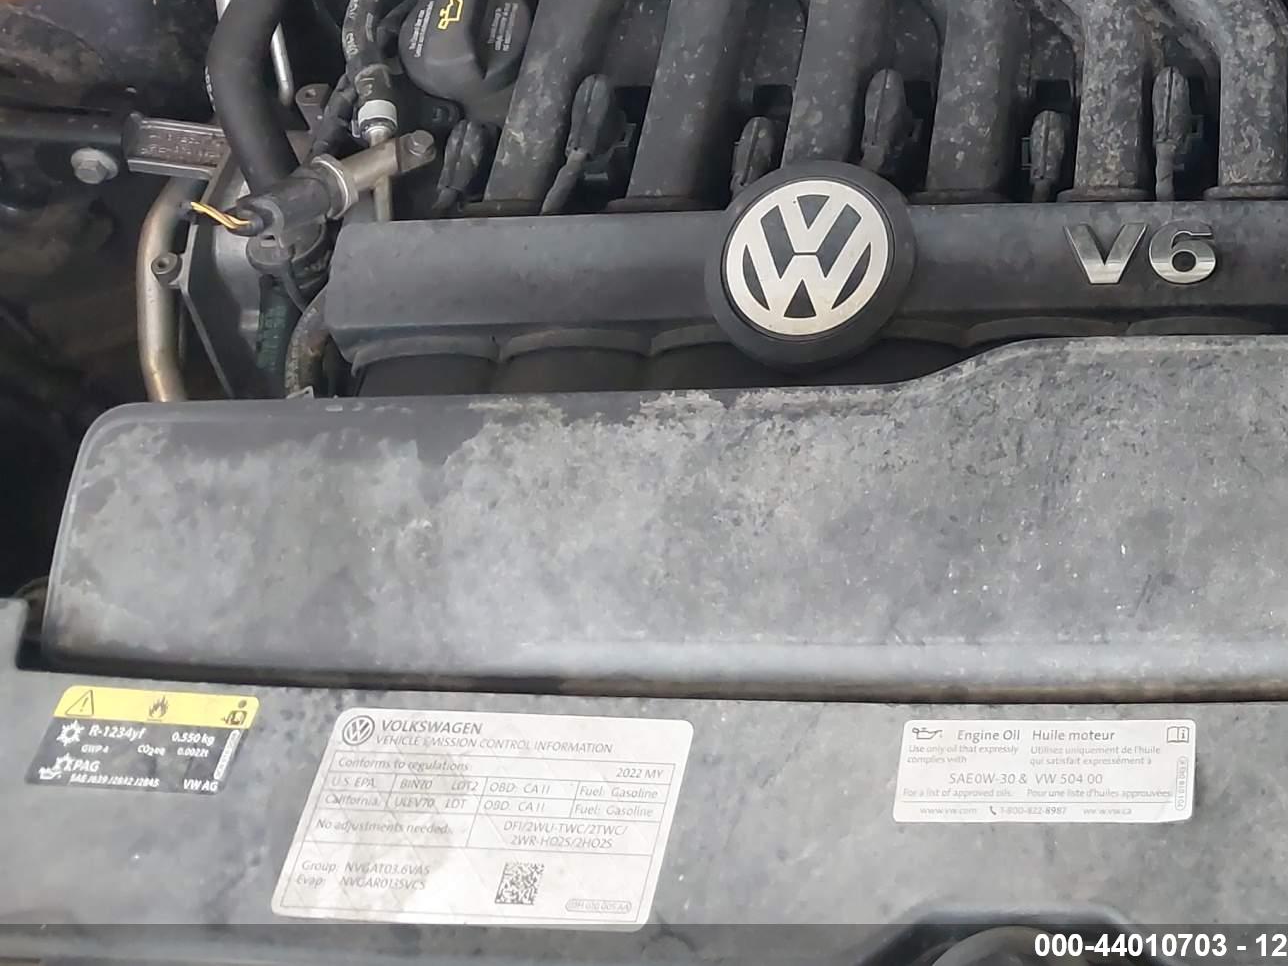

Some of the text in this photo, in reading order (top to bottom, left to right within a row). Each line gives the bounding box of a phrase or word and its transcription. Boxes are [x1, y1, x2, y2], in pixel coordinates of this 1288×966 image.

[1064, 220, 1218, 285] V6
[382, 720, 484, 735] VOLKSWAGEN
[89, 725, 146, 742] R-1234yf
[200, 734, 215, 746] kg
[957, 730, 1020, 744] Engine Oil
[1032, 730, 1115, 741] Huile moteur
[376, 735, 614, 754] VEHICLE EMISSION CONTROL INFORMATION
[72, 758, 100, 772] PAG
[338, 756, 664, 779] Conforms to 2022 MY
[183, 779, 218, 792] VW AG
[1018, 774, 1103, 784] & VW 504 00
[524, 783, 538, 794] CA
[611, 786, 658, 798] Gasoline
[518, 800, 534, 811] CA
[606, 805, 654, 818] Gasoline
[316, 818, 404, 834] No adjustments
